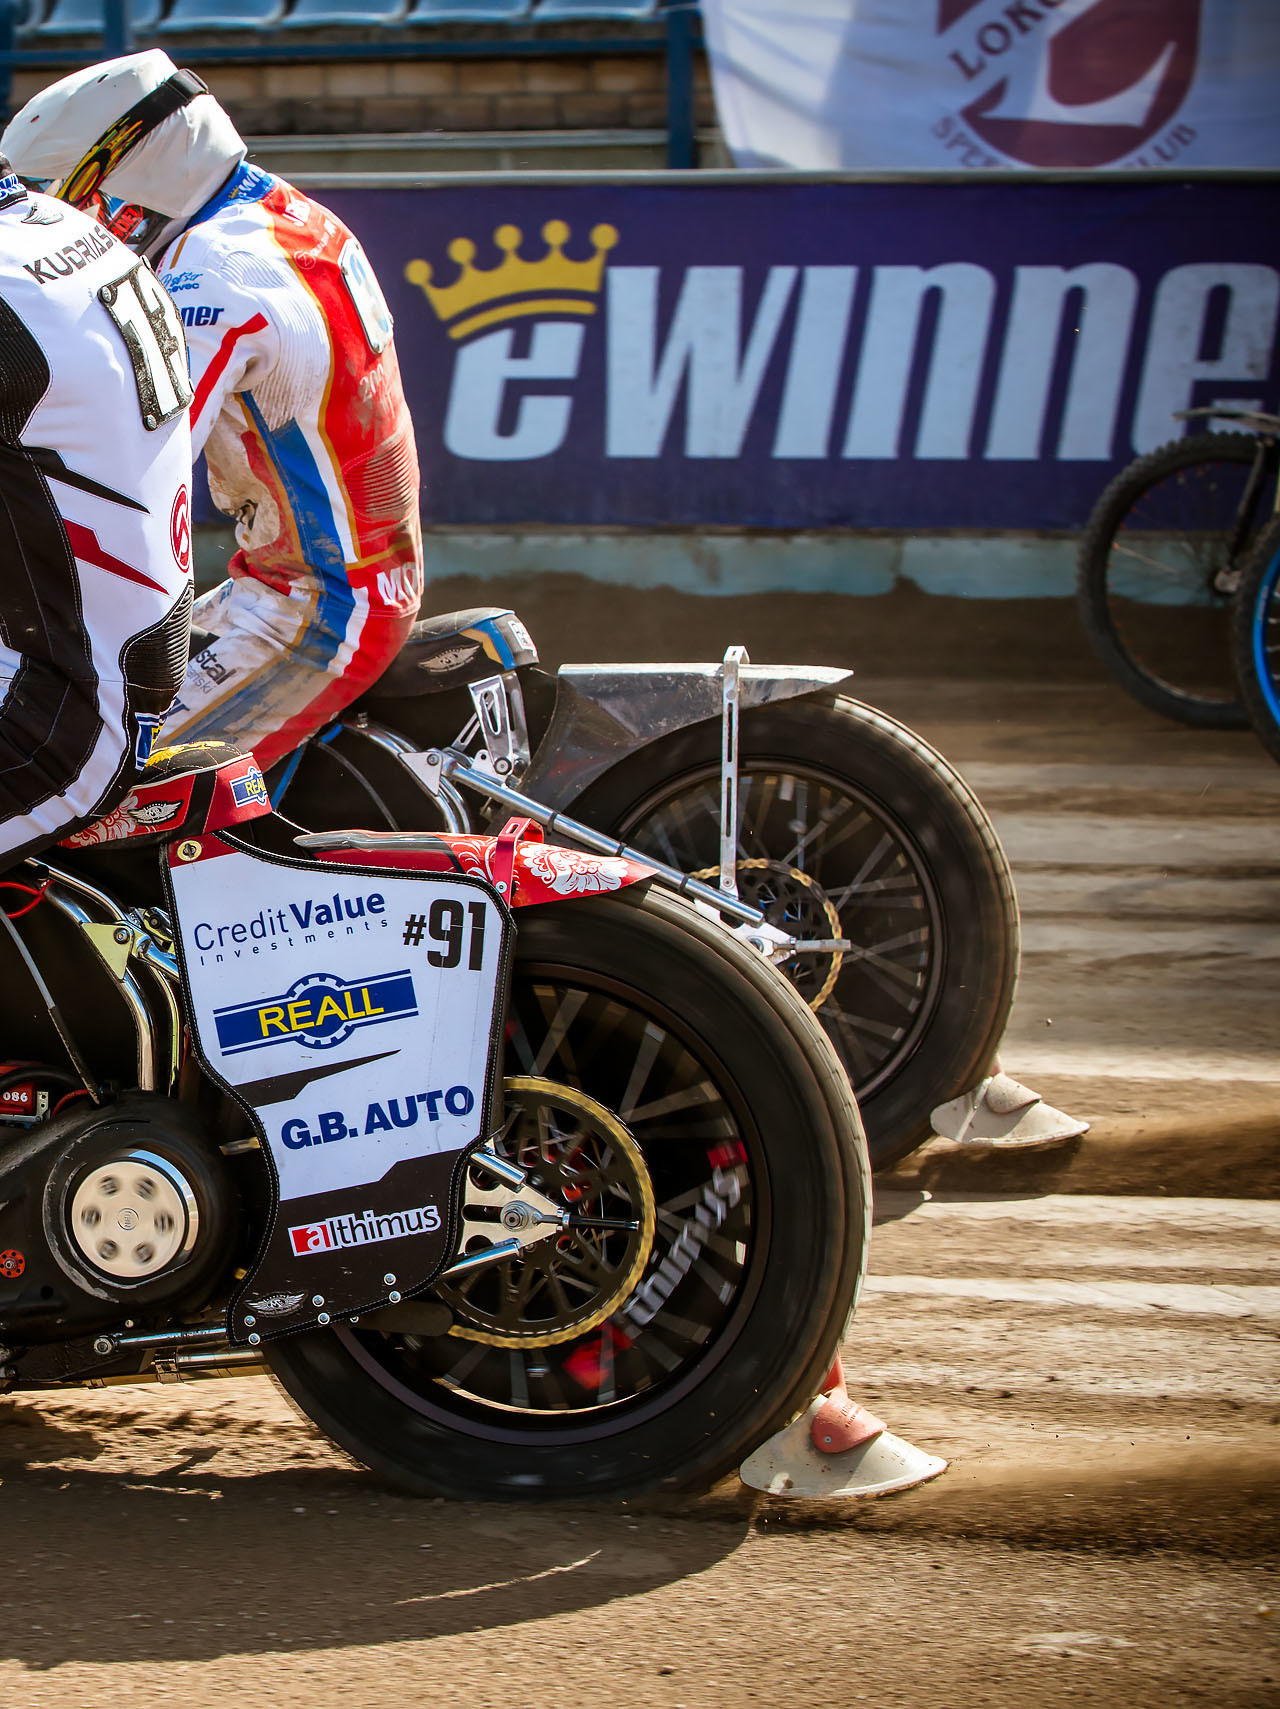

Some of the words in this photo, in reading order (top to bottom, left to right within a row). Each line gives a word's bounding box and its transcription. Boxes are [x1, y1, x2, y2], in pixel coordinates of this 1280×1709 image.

[22, 224, 118, 284] KUDRIAS
[402, 898, 488, 971] #91
[258, 987, 384, 1038] REALL
[2, 1091, 29, 1103] 086
[280, 1111, 359, 1150] G.B.
[363, 1085, 475, 1137] AUTO
[307, 1206, 440, 1250] althimus
